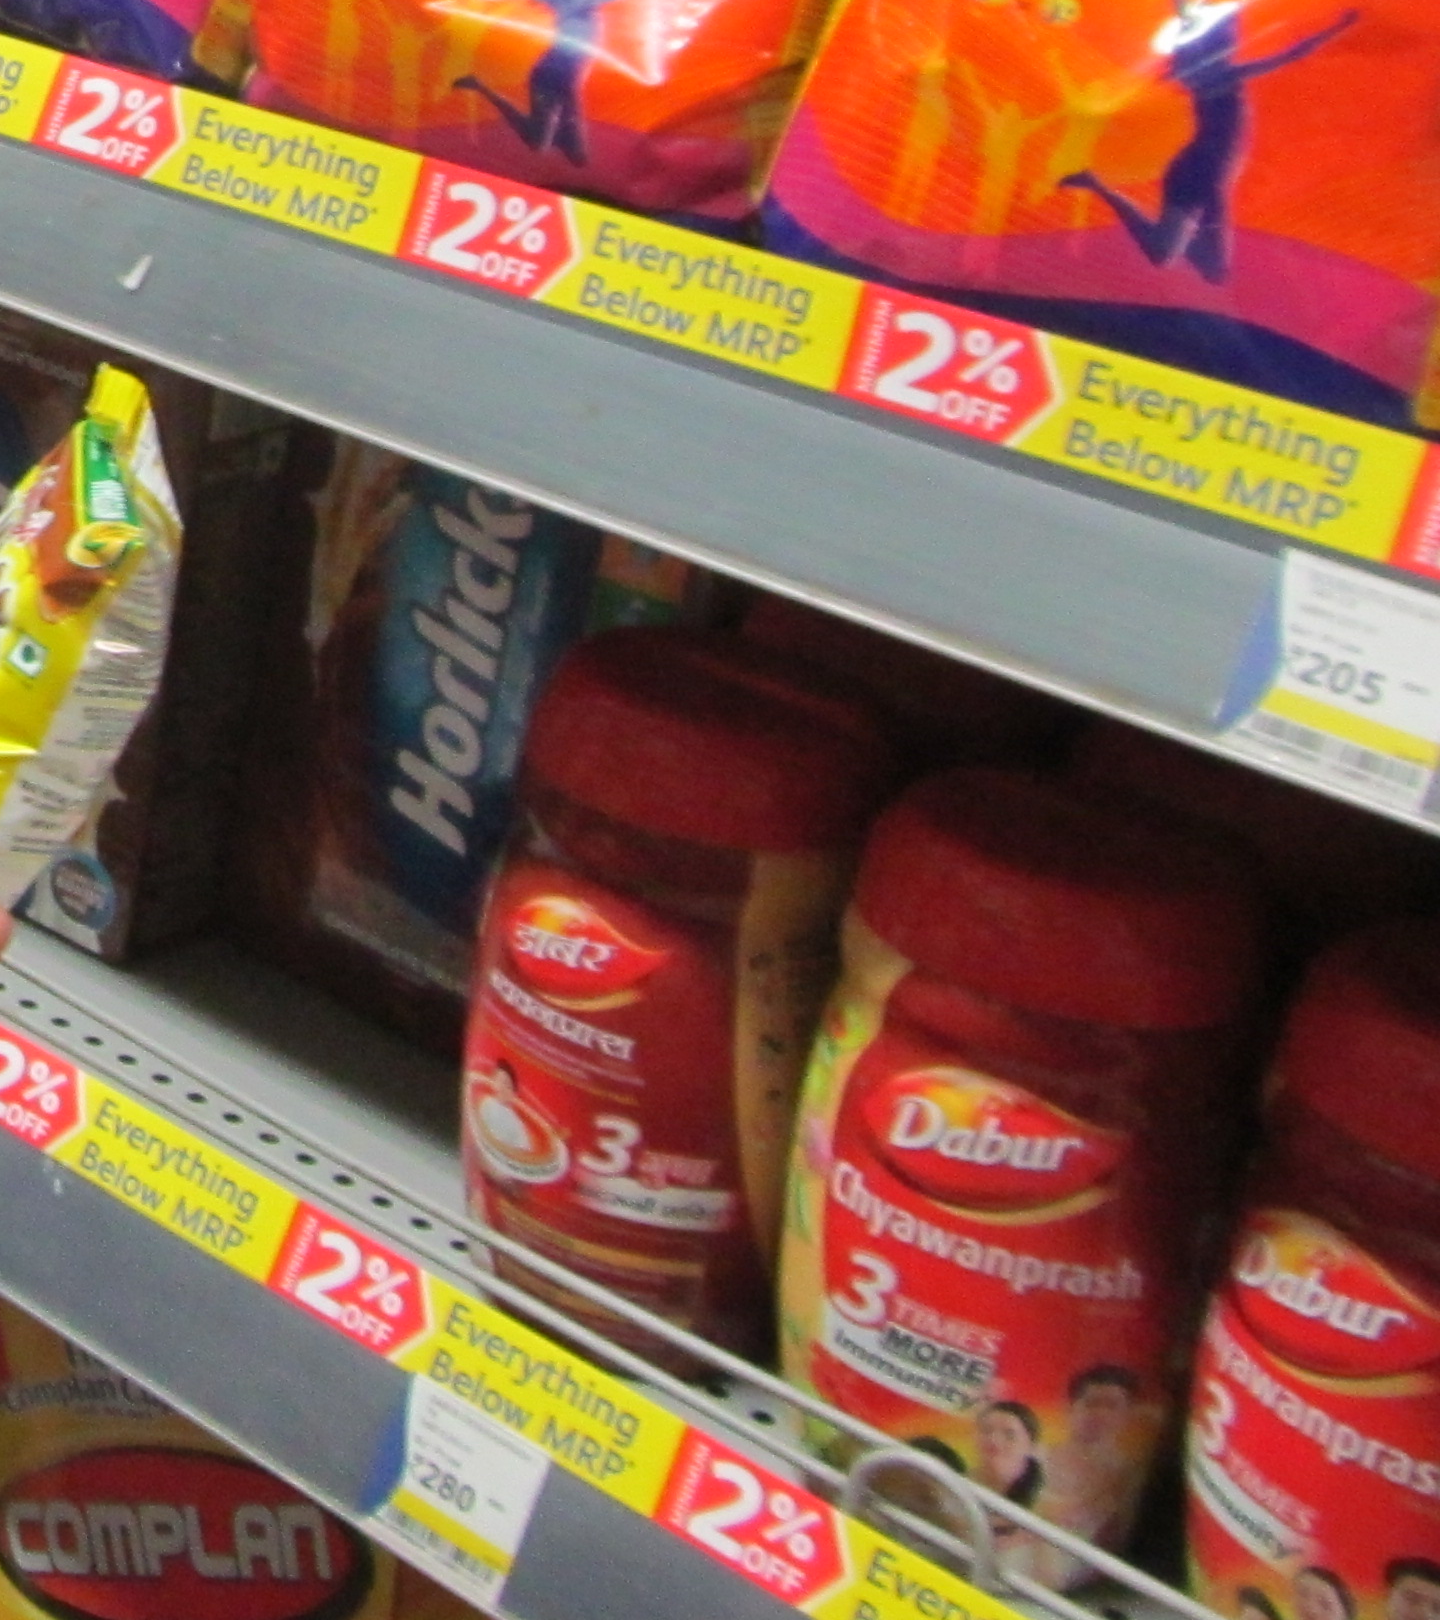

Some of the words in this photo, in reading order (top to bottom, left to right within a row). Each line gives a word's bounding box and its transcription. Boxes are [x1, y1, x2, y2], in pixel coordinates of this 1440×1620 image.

[59, 76, 164, 156] 2%
[100, 139, 149, 170] OFF
[192, 107, 380, 196] Everything
[180, 153, 277, 207] Below
[428, 182, 551, 273] 2%
[480, 249, 538, 288] OFF
[577, 272, 694, 335] Below
[592, 220, 814, 325] Everything
[873, 310, 1025, 412] 2%
[937, 390, 1013, 433] OFF
[1077, 360, 1363, 487] Everything
[1063, 421, 1212, 494] Below
[4, 1106, 53, 1143] OFF
[94, 1096, 260, 1223] Everything
[889, 1094, 1085, 1172] Dabur
[78, 1139, 167, 1210] Below
[829, 1159, 1145, 1300] Chyawanprash
[297, 1227, 411, 1322] 2%
[829, 1250, 900, 1328] 3
[1234, 1236, 1408, 1340] Dabur
[339, 1303, 395, 1347] OFF
[878, 1326, 996, 1383] MORE
[428, 1348, 536, 1429] Below
[444, 1301, 641, 1447] Everything
[4, 1499, 332, 1581] COMPLAN
[685, 1459, 820, 1562] 2%
[738, 1542, 807, 1594] OFF
